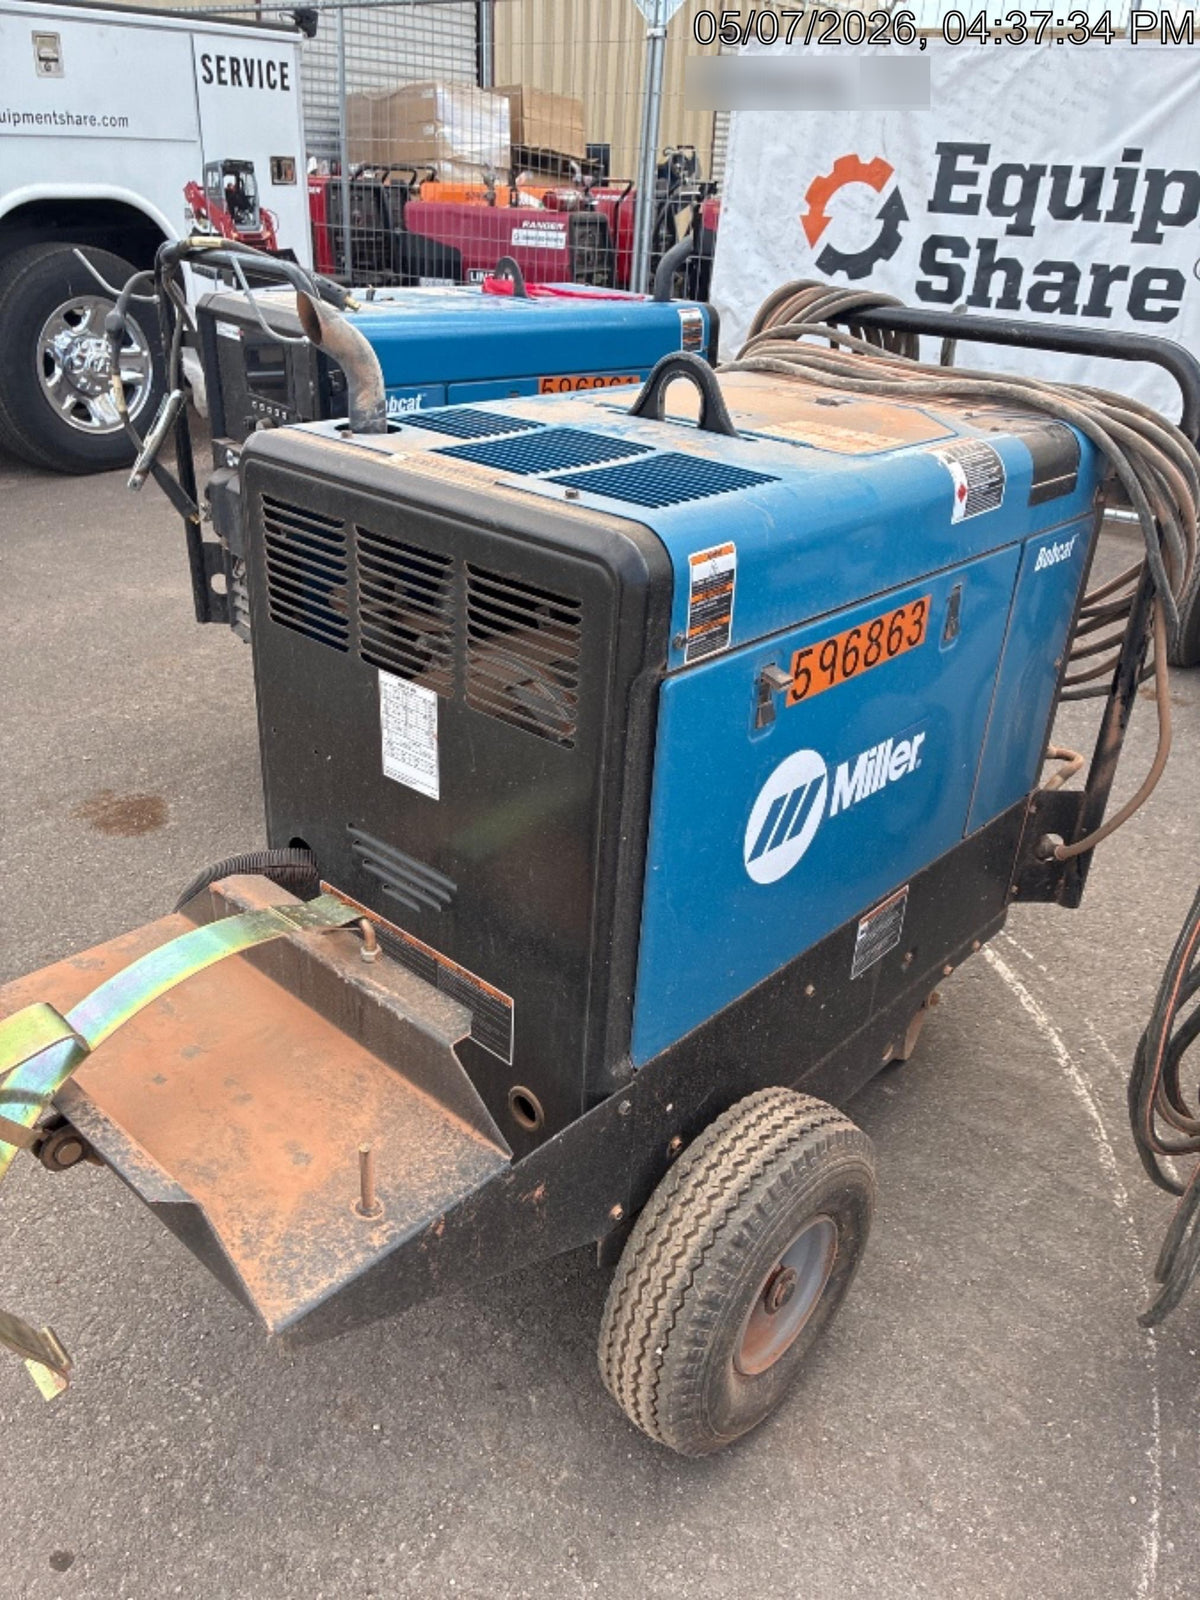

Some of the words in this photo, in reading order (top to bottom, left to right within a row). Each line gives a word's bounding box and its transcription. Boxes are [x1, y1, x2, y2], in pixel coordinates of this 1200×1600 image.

[200, 53, 291, 92] SERVICE
[927, 141, 1200, 244] Equip
[915, 234, 1186, 323] Share
[385, 393, 423, 412] bcat
[1034, 535, 1077, 572] Bobcat
[789, 599, 927, 701] 596863
[828, 731, 926, 818] Miller
